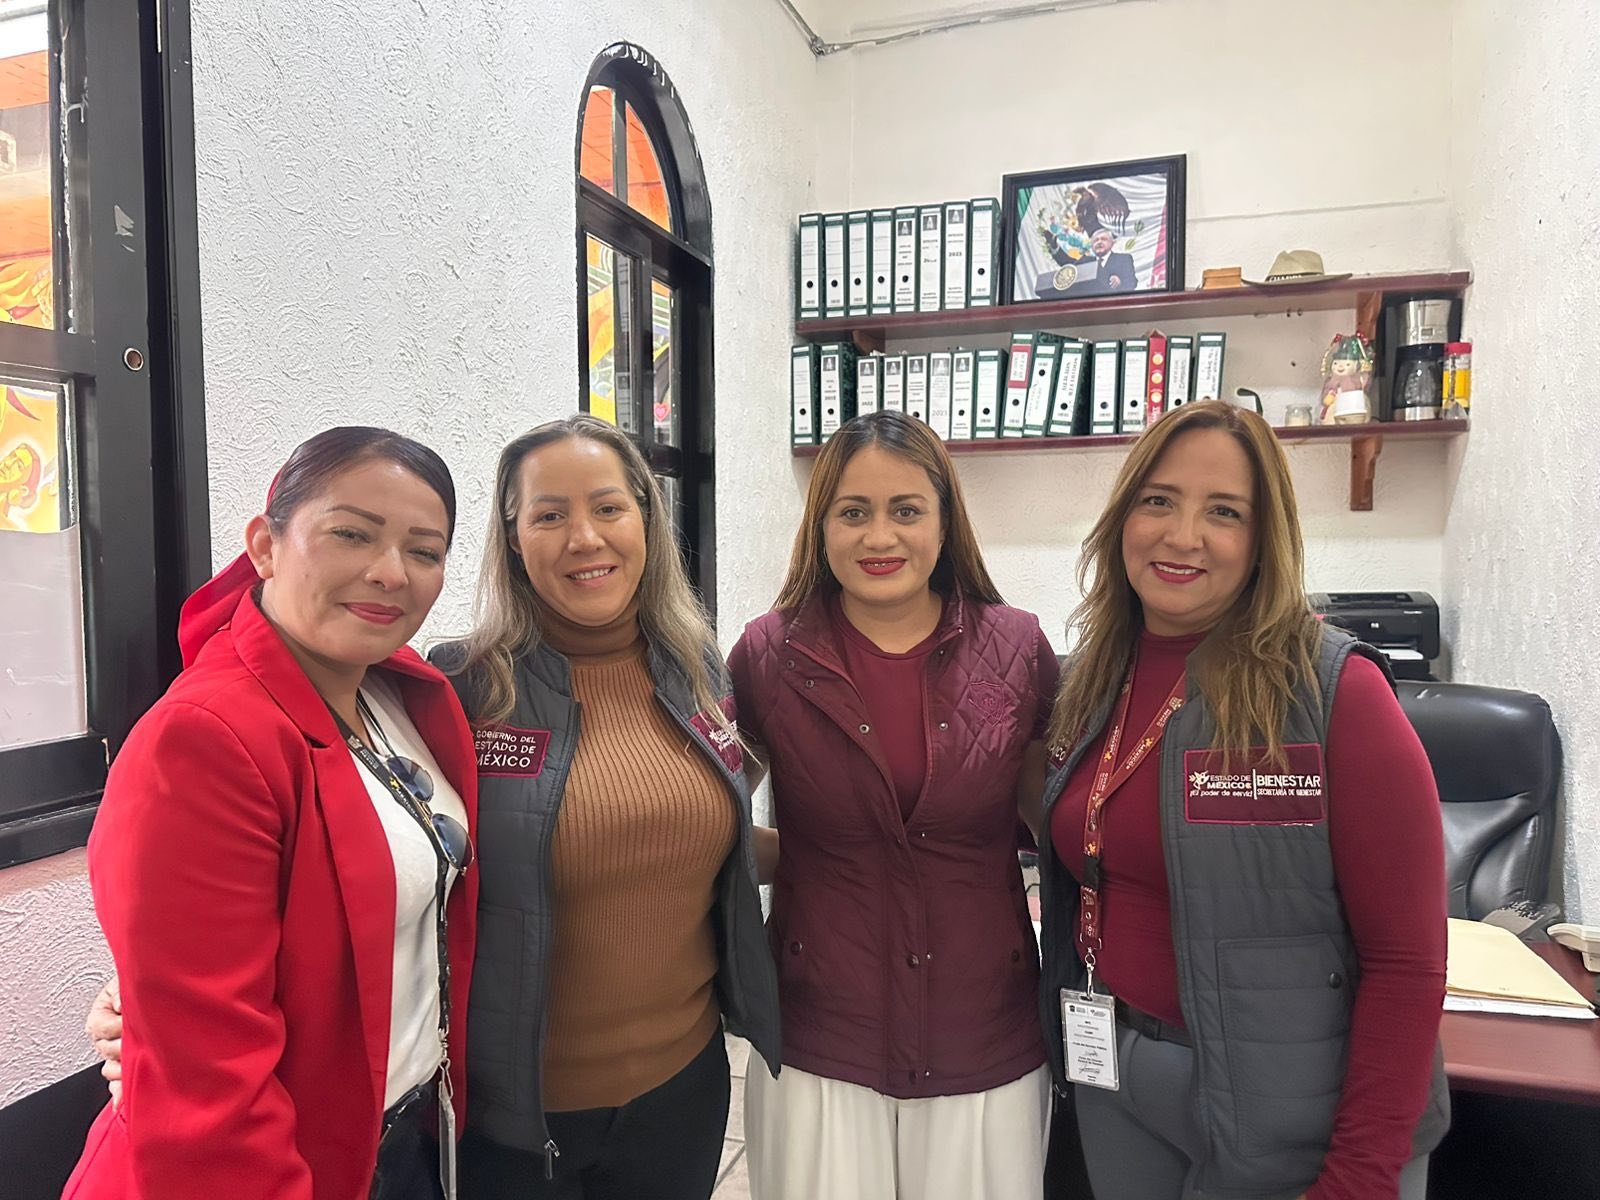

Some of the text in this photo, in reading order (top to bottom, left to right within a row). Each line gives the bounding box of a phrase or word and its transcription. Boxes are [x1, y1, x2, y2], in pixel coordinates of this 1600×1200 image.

[476, 730, 536, 744] GOBIERNO DEL
[475, 741, 536, 754] ESTADO DE
[1210, 774, 1252, 782] ESTADO DE
[1256, 774, 1321, 788] BIENESTAR
